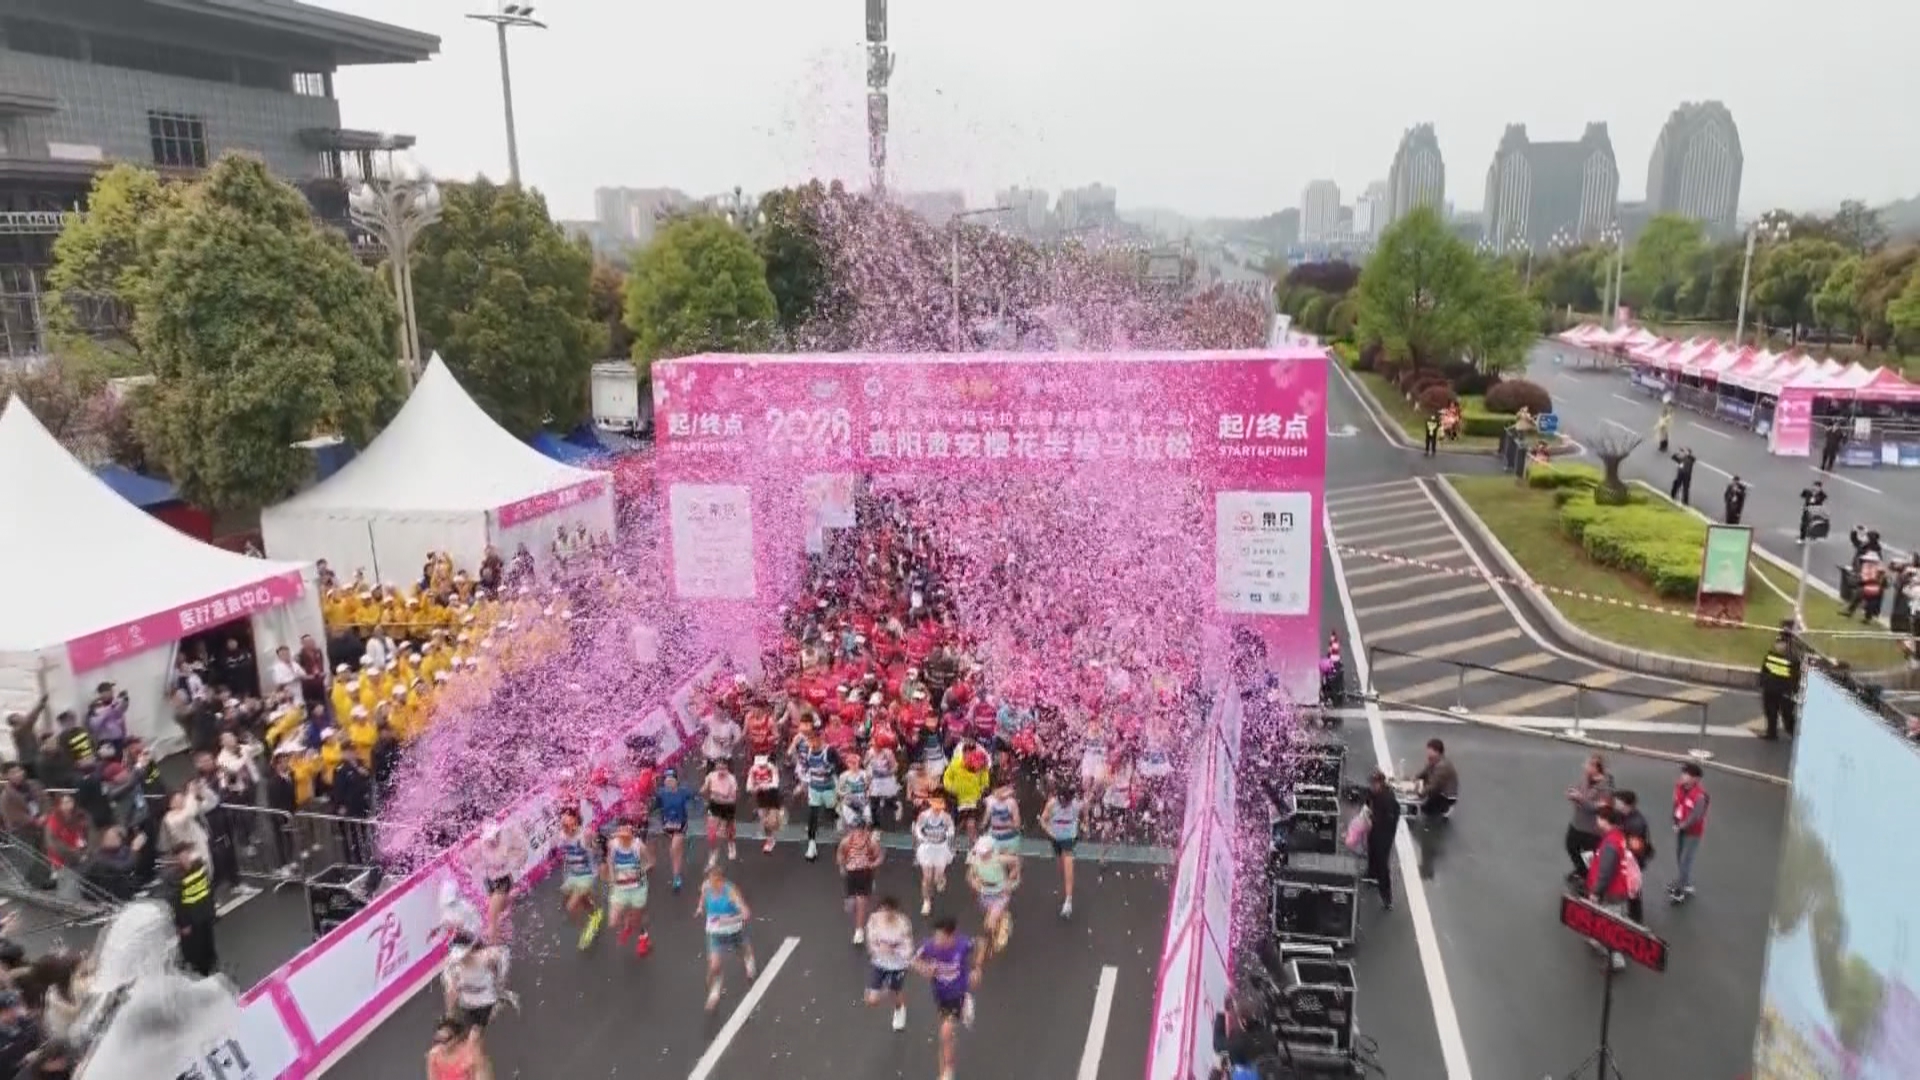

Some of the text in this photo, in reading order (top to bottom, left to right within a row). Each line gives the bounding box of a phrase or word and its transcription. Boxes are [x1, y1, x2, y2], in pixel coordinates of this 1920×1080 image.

[668, 411, 744, 436] 起/终点
[1219, 413, 1308, 439] 起/终点
[1219, 445, 1308, 457] START&FINISH
